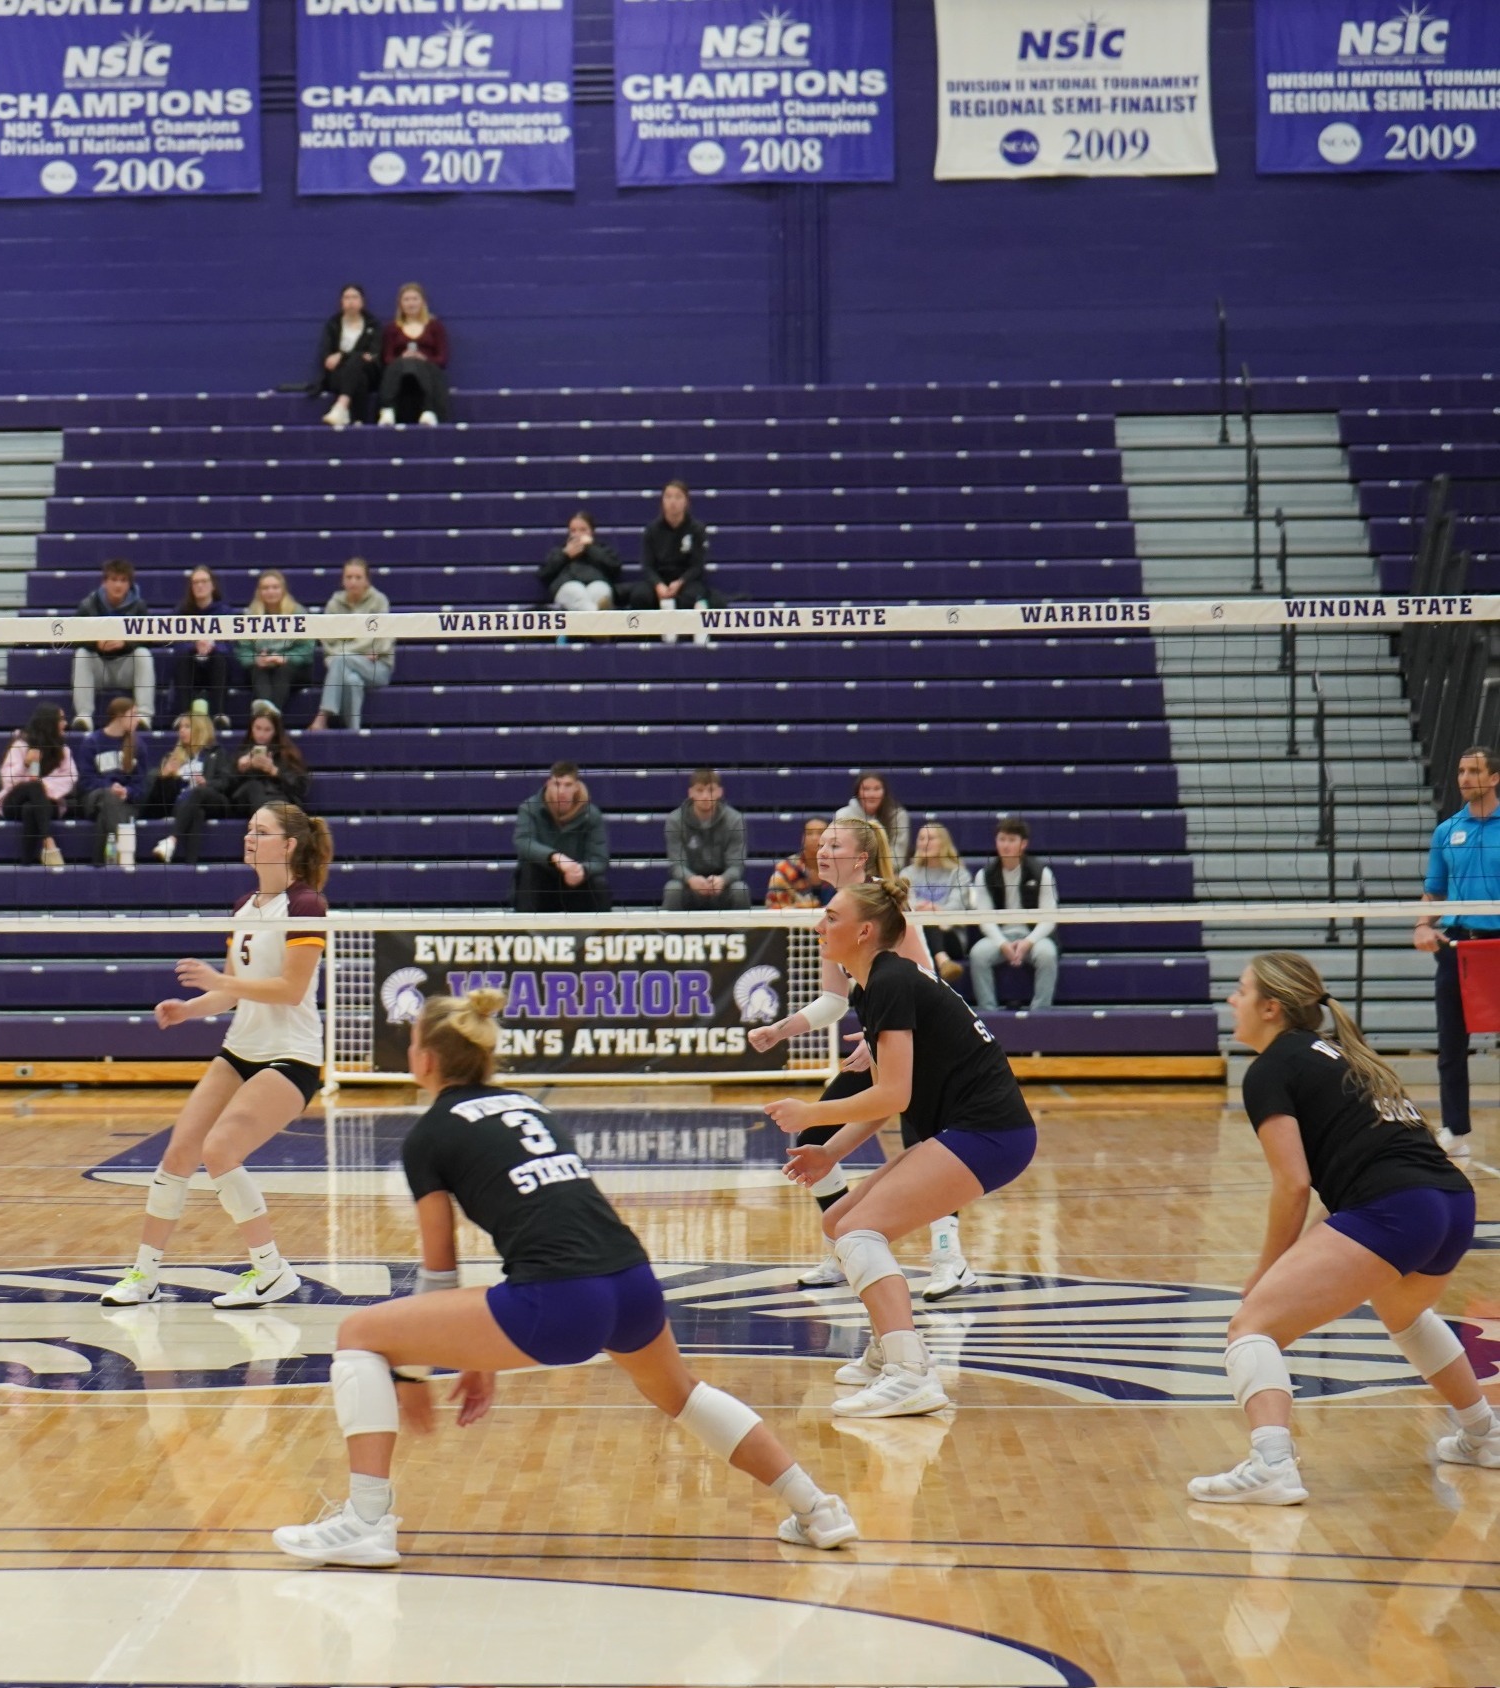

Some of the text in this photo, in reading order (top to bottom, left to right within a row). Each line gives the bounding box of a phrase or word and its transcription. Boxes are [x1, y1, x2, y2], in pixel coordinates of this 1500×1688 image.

[700, 20, 812, 58] NSIC
[1017, 24, 1126, 61] NSIC
[1338, 14, 1449, 56] NSIC
[63, 40, 172, 78] NSIC
[383, 30, 494, 69] NSIC
[621, 69, 888, 101] CHAMPIONS
[946, 75, 1199, 93] DIVISION II NATIONAL TOURNAMENT
[1267, 72, 1334, 90] DIVISION
[1351, 70, 1422, 88] NATIONAL
[301, 82, 571, 108] CHAMPIONS
[949, 95, 1197, 118] REGIONAL SEMI-FINALIST
[1269, 91, 1370, 114] REGIONAL
[311, 110, 562, 130] NSIC Tournament Champions
[631, 100, 879, 121] NSIC Tournament Champions
[4, 118, 240, 139] NSIC Tournament Champions
[300, 132, 345, 148] NCAA
[348, 131, 376, 147] DIV
[394, 129, 474, 146] NATIONAL
[477, 127, 571, 145] RUNNER-UP
[638, 122, 699, 139] Division
[718, 120, 782, 137] National
[786, 118, 871, 137] Champions
[1385, 123, 1477, 161] 2009
[0, 135, 245, 156] Division II National Champions
[741, 138, 823, 173] 2008
[1063, 128, 1150, 162] 2009
[92, 157, 205, 193] 2006
[421, 150, 503, 184] 2007
[701, 608, 887, 629] WINONA STATE
[1020, 604, 1151, 623] WARRIORS
[1285, 598, 1474, 619] WINONA STATE
[123, 616, 306, 636] WINONA STATE
[439, 613, 567, 632] WARRIORS
[240, 934, 253, 966] 5
[414, 933, 746, 963] EVERYONE SUPPORTS
[571, 1027, 747, 1056] ATHLETICS
[501, 1110, 557, 1155] 3
[508, 1154, 592, 1195] STATE
